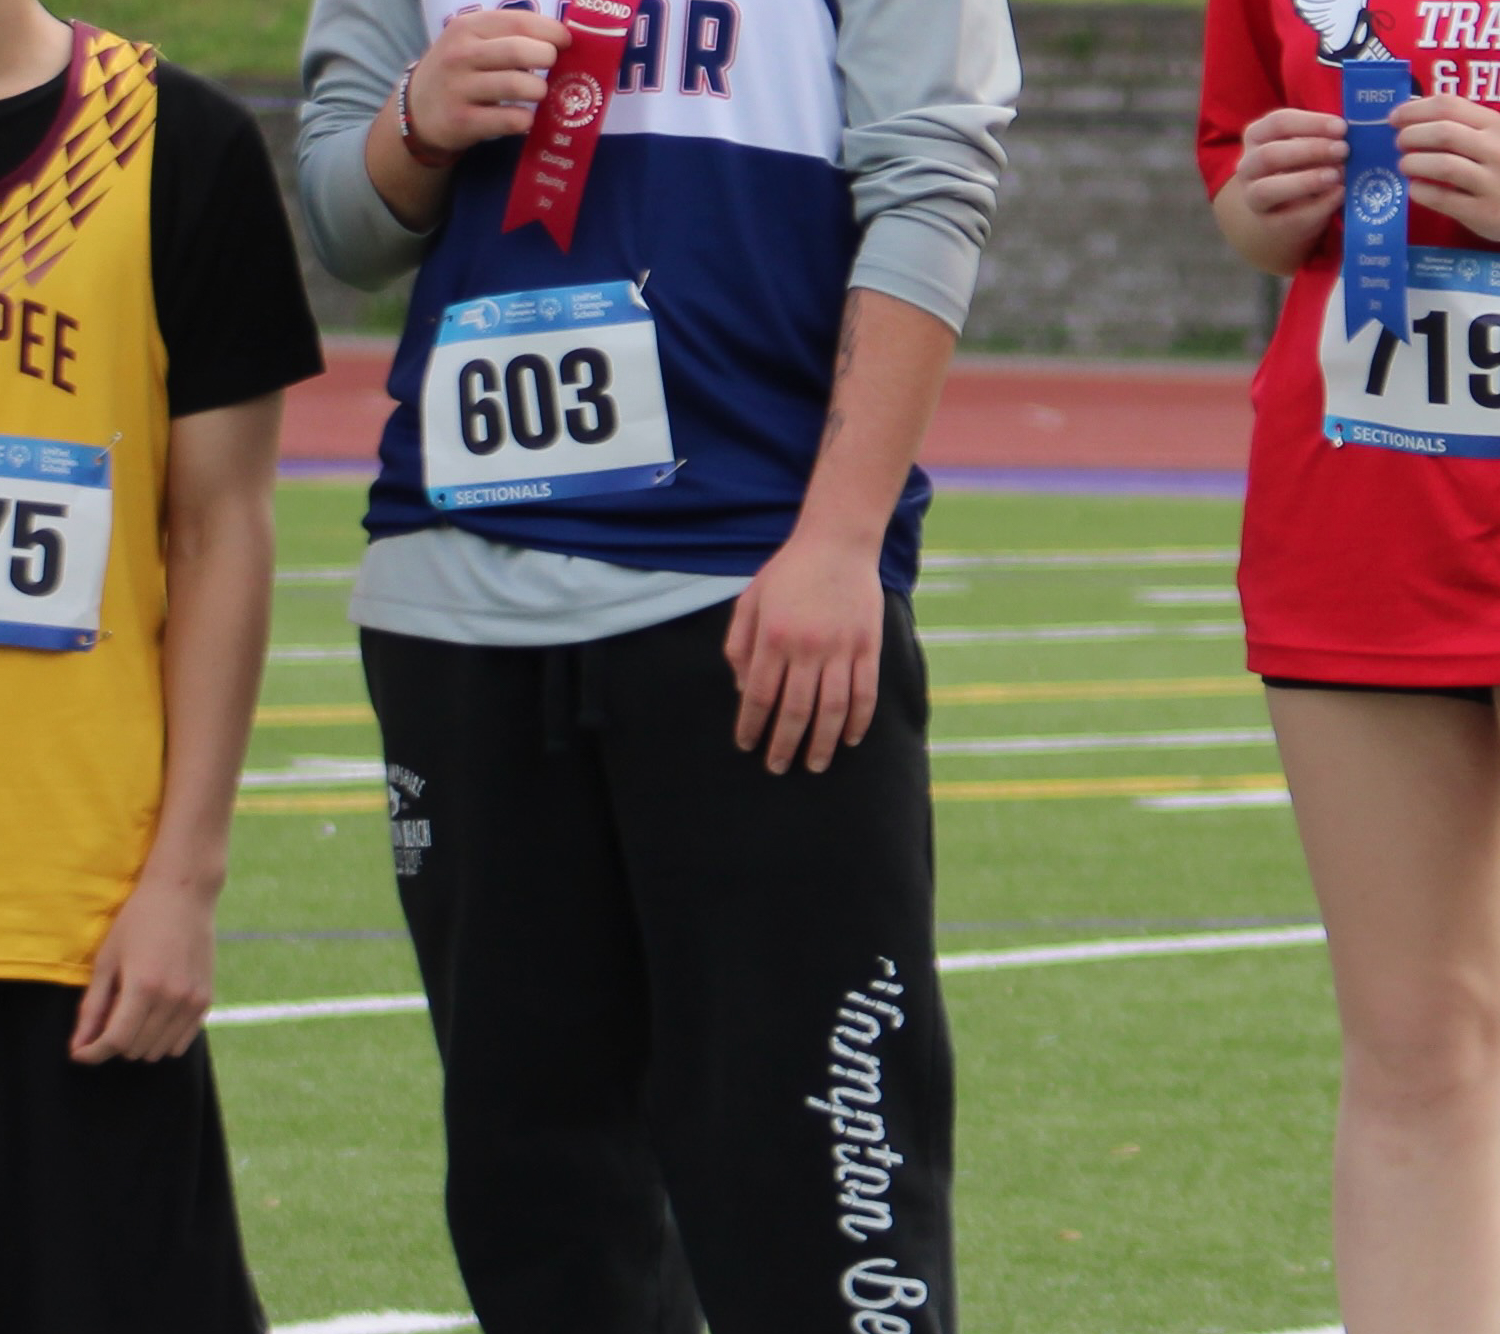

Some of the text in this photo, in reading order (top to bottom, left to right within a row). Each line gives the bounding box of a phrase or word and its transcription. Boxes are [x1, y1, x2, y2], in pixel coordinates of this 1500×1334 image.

[1432, 59, 1460, 97] &
[1357, 89, 1397, 104] FIRST
[459, 347, 620, 456] 603
[1352, 425, 1447, 454] SECTIONALS
[455, 482, 553, 506] SECTIONALS
